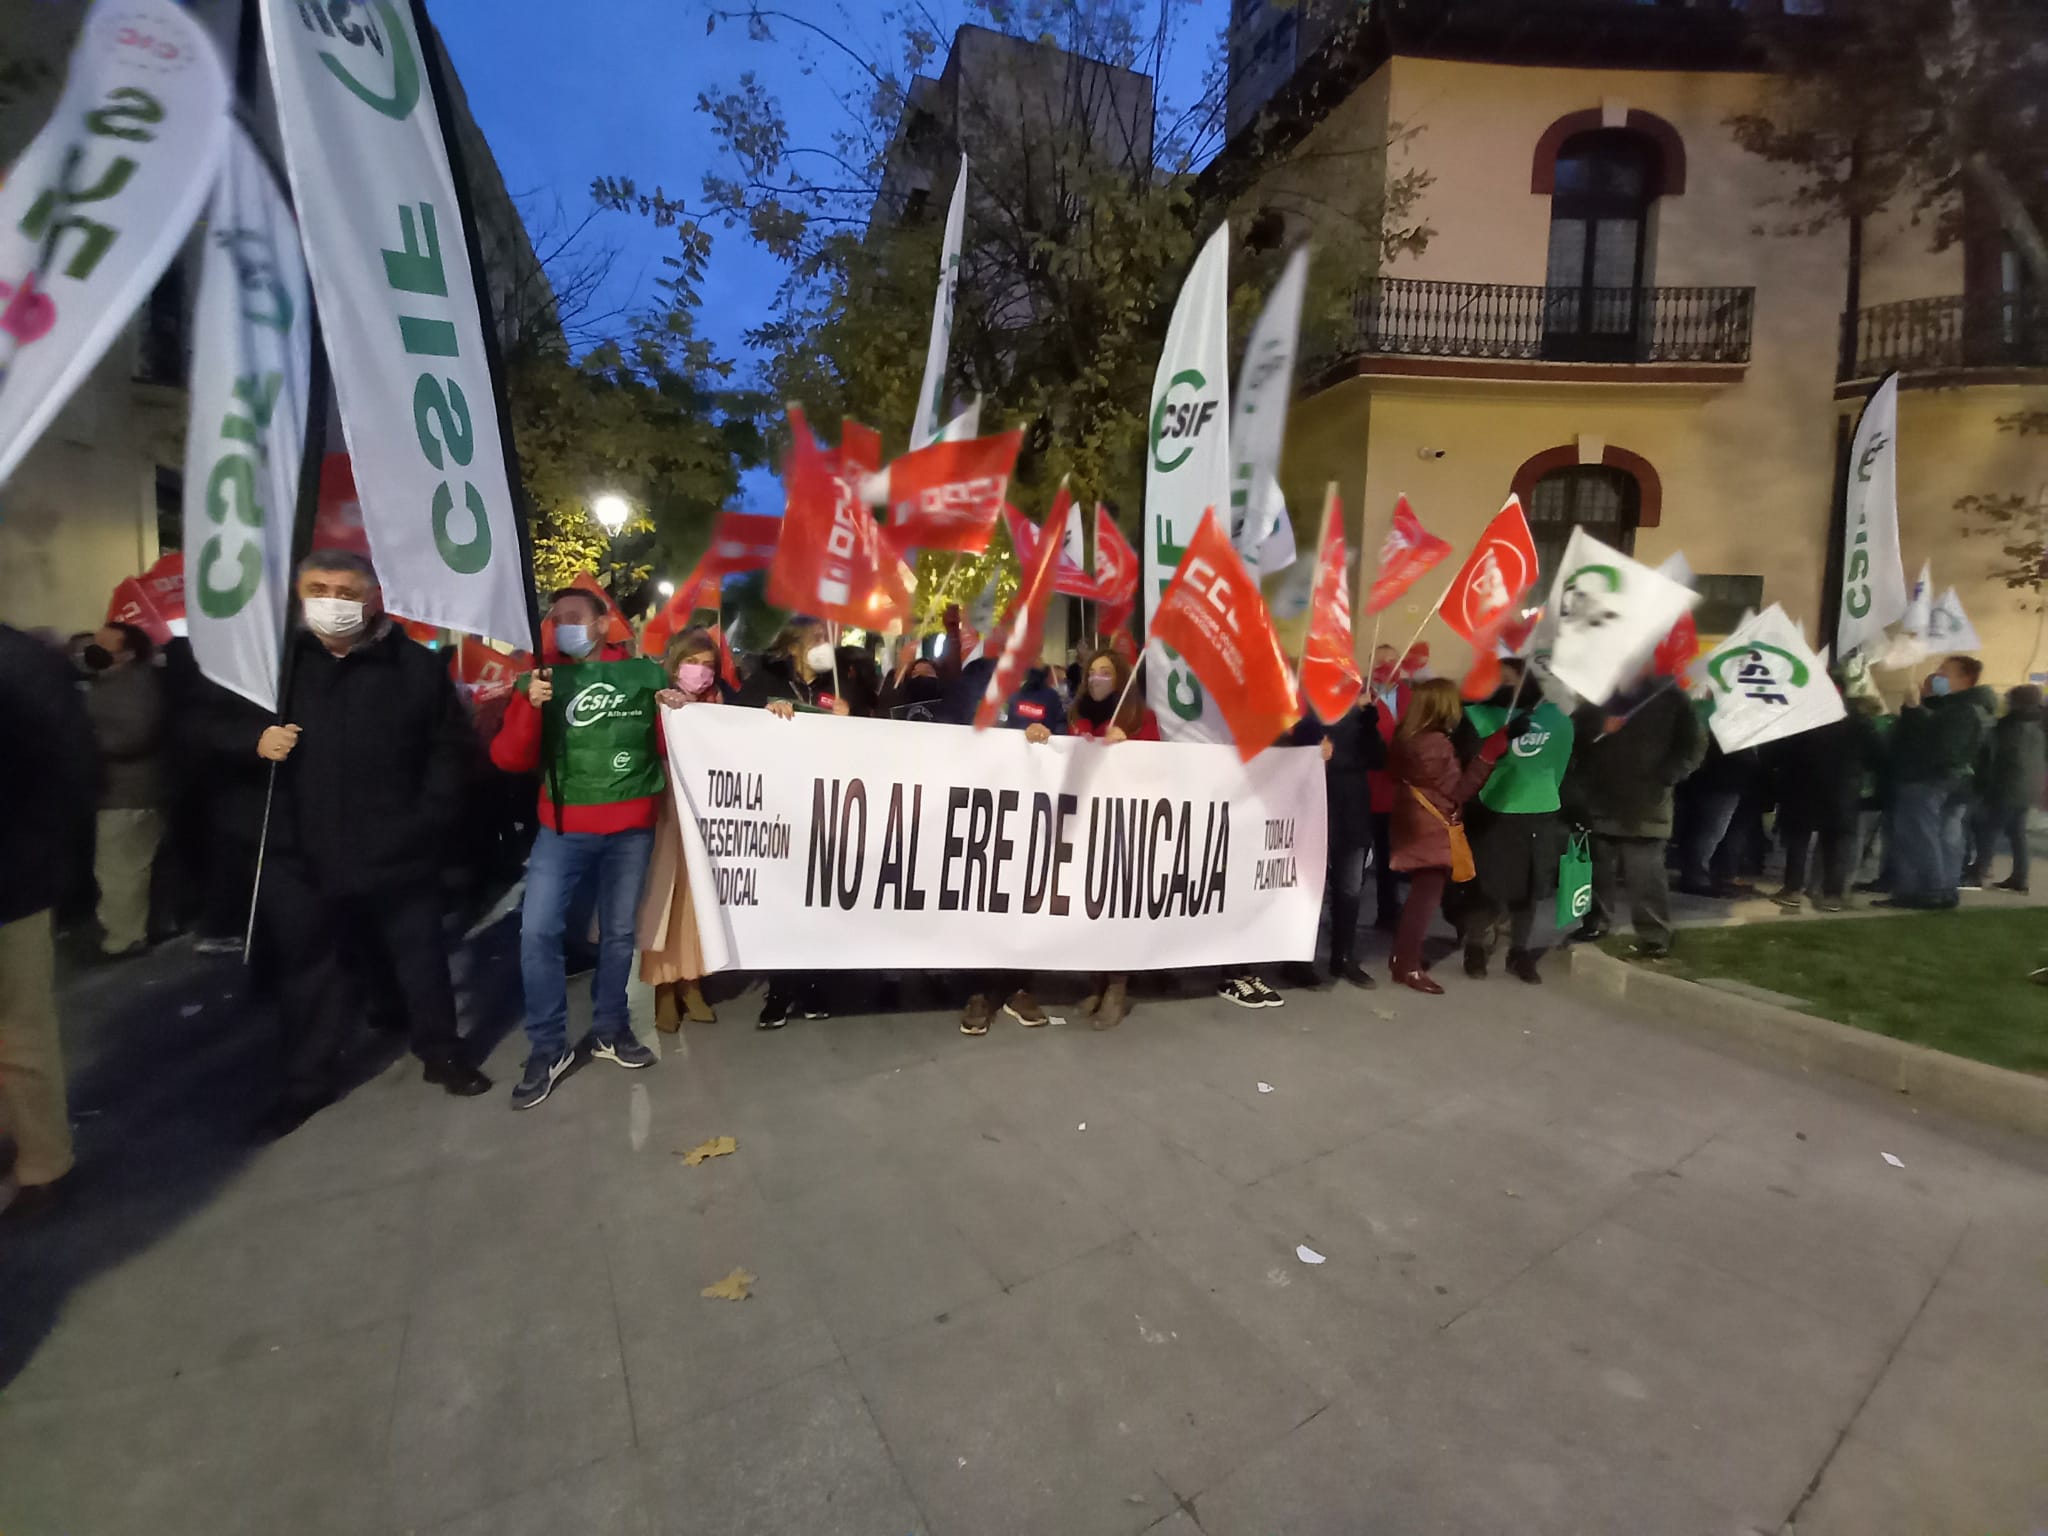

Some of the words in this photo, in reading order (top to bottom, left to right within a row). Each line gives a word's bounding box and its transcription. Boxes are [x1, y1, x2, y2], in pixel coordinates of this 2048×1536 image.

[1160, 400, 1219, 440] CSIF
[708, 769, 742, 809] TODA
[746, 773, 763, 811] LA
[699, 814, 791, 859] RESENTACIÓN
[804, 777, 867, 911] NO
[874, 782, 926, 911] AL
[938, 786, 1020, 914] ERE
[1022, 791, 1078, 917] DE
[1084, 797, 1230, 921] UNICAJA
[1264, 819, 1284, 850] TODA
[1284, 817, 1295, 849] LA
[711, 867, 758, 906] NDICAL
[1254, 856, 1298, 890] PLANTILLA
